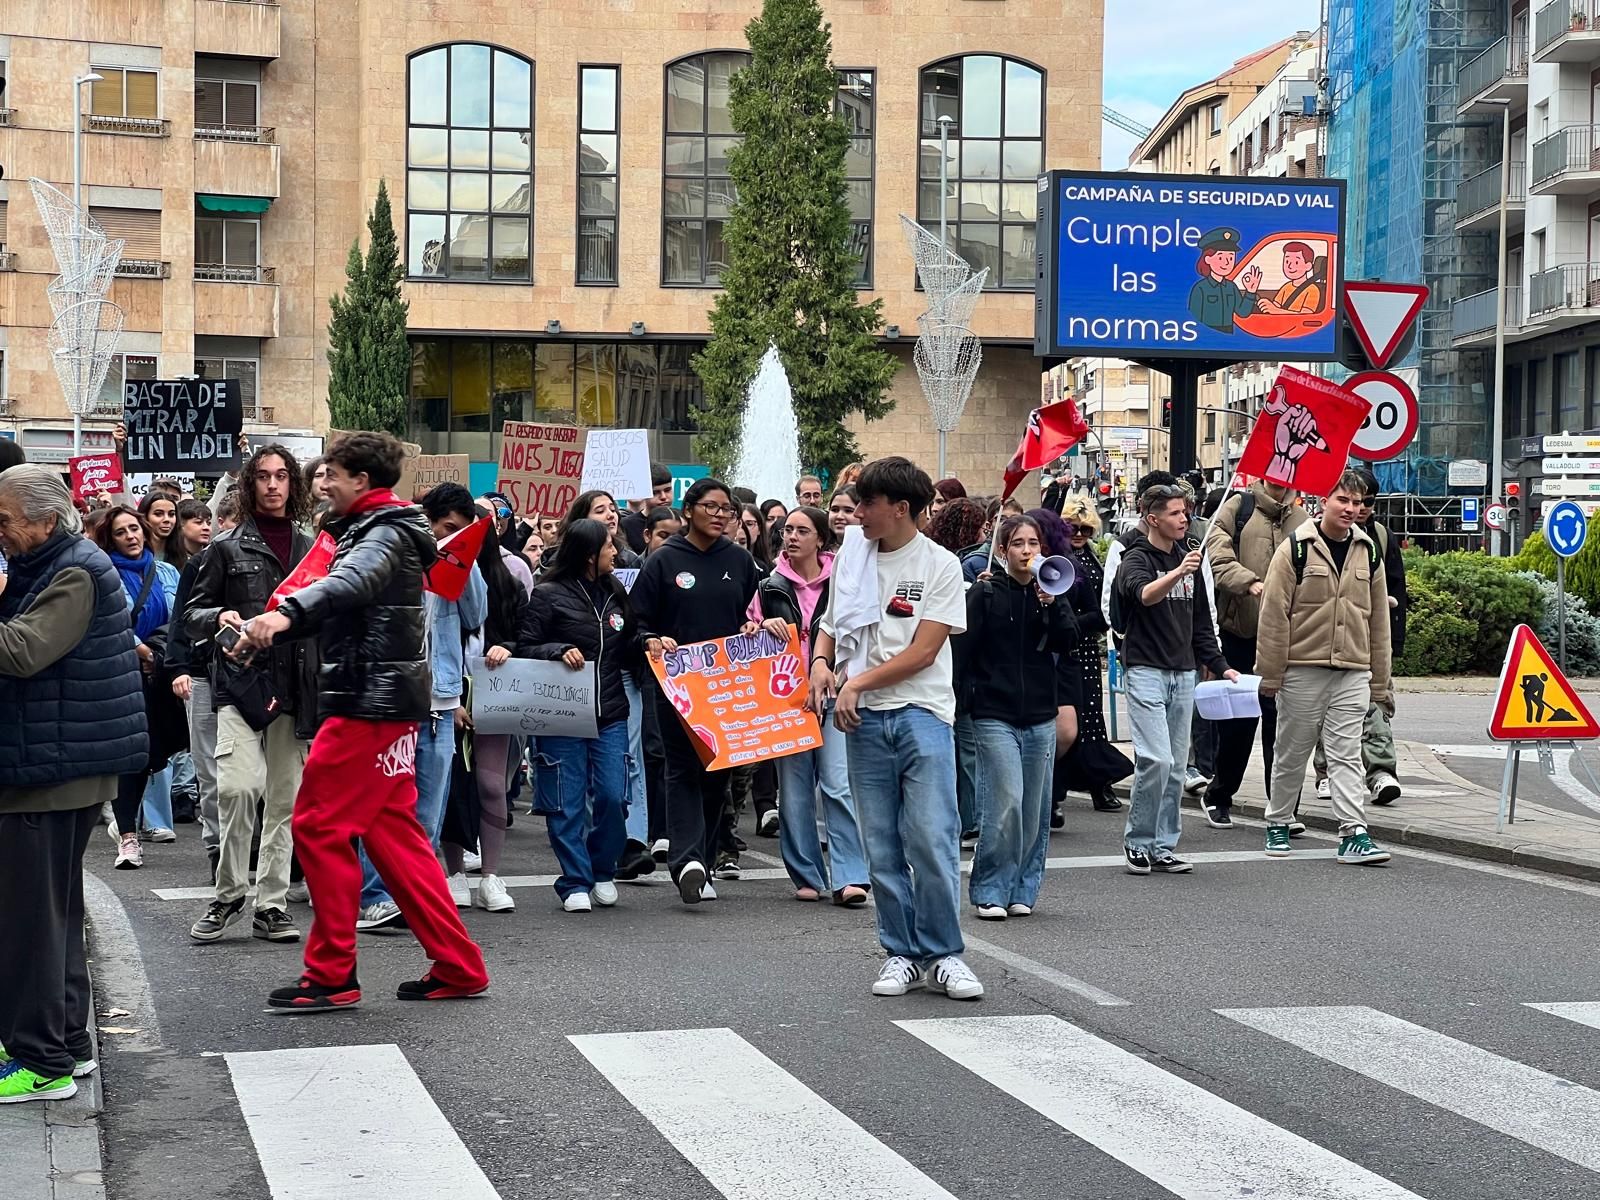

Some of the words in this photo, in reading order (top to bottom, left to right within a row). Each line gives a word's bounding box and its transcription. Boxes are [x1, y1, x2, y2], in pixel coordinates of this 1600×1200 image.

[1065, 185, 1154, 203] CAMPAÑA
[1159, 190, 1184, 204] DE
[1188, 191, 1290, 207] SEGURIDAD
[1294, 194, 1334, 208] VIAL
[1067, 216, 1202, 253] Cumple
[1113, 263, 1157, 293] las
[1069, 317, 1198, 342] normas
[124, 382, 194, 408] BASTA
[198, 382, 226, 408] DE
[124, 408, 199, 434] MIRAR
[203, 407, 217, 433] A
[127, 434, 165, 460] UN
[176, 433, 233, 460] LADO
[503, 442, 525, 470] NO
[525, 443, 543, 471] ES
[592, 449, 631, 467] SALUD
[896, 588, 922, 601] 95
[489, 677, 504, 692] NO
[509, 679, 524, 693] AL
